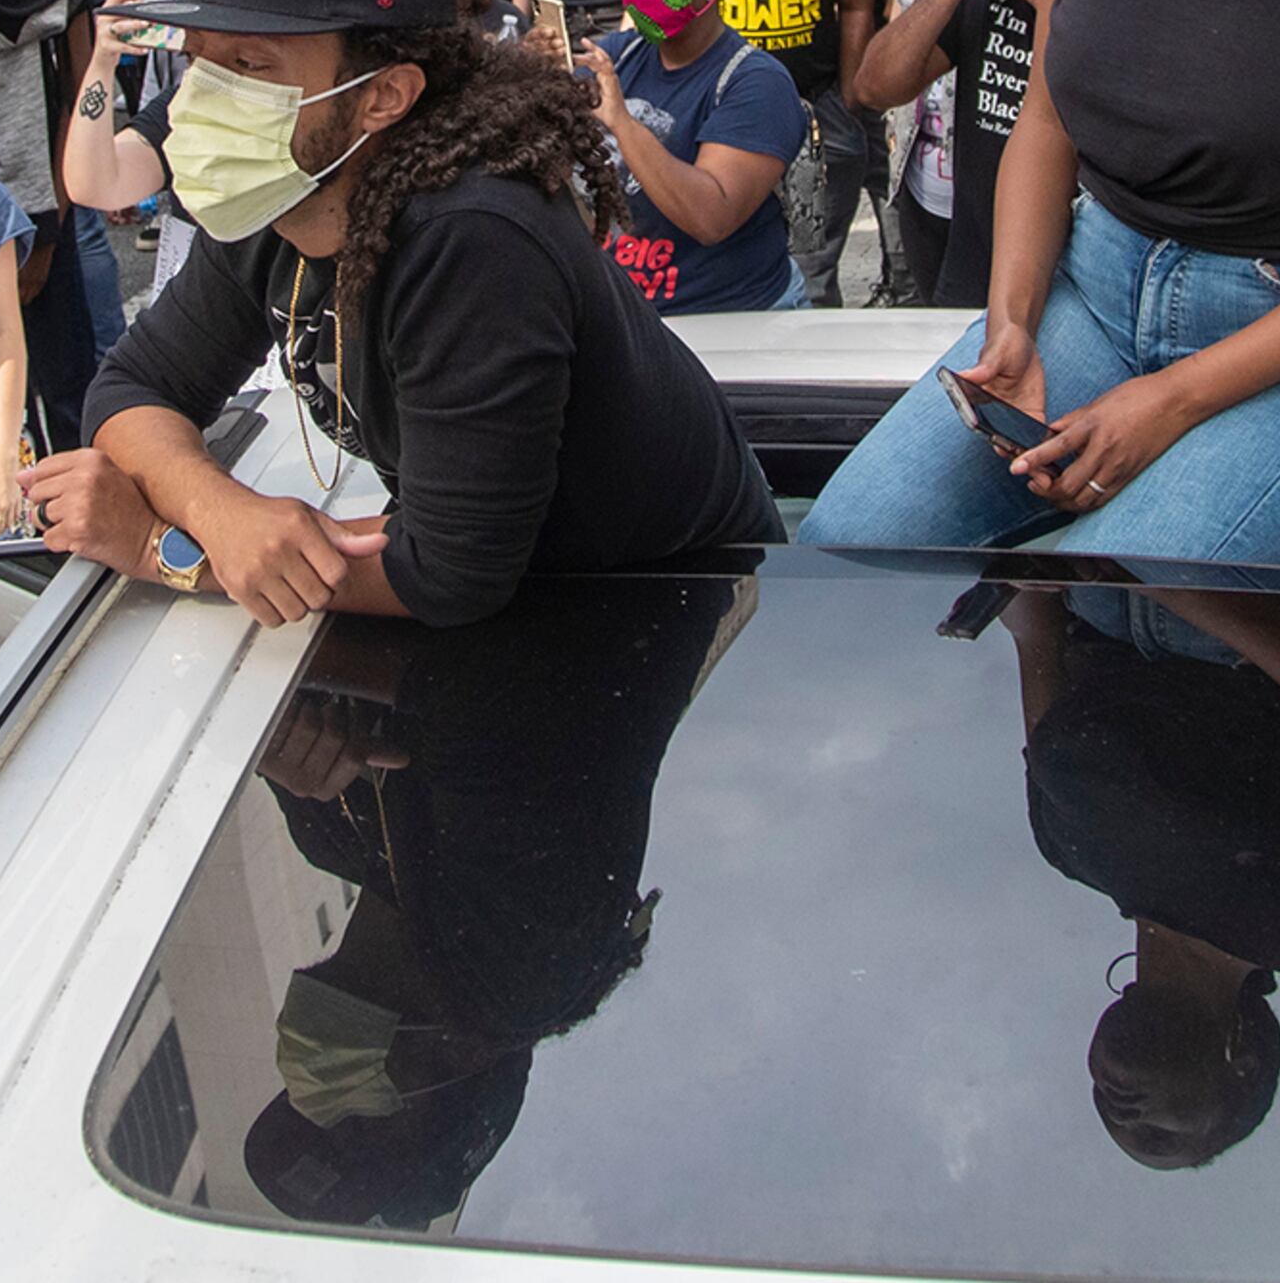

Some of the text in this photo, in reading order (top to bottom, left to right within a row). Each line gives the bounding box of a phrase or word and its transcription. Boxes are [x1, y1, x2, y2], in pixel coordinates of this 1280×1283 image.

[766, 31, 813, 51] ENEMY
[985, 31, 1034, 67] Root
[977, 87, 1025, 121] Blac
[614, 234, 675, 270] BIG
